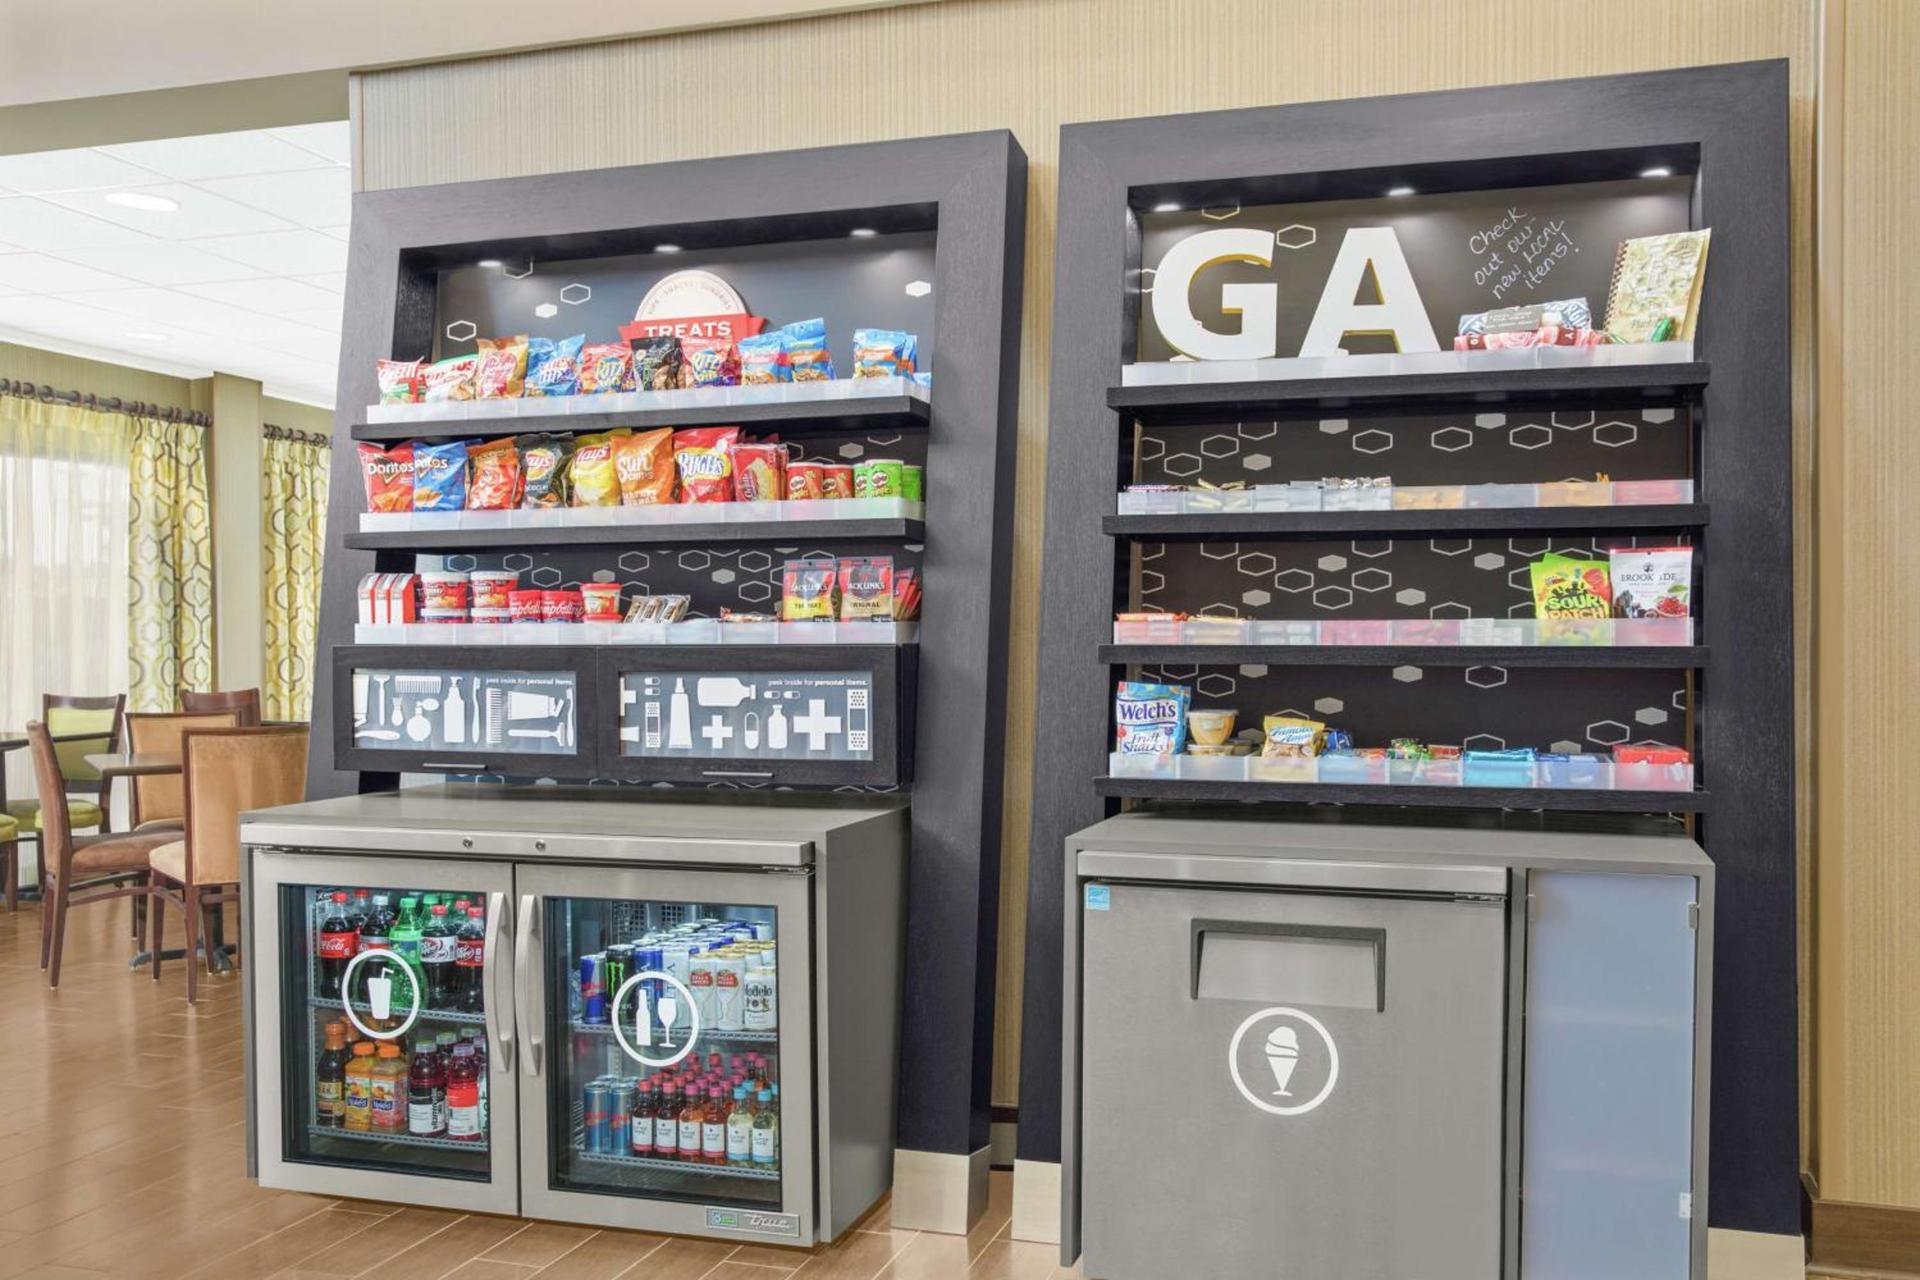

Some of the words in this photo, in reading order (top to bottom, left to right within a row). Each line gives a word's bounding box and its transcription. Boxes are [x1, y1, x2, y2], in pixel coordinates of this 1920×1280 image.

[1469, 207, 1528, 254] Check
[1474, 252, 1504, 285] out
[1507, 217, 1536, 253] our
[1492, 264, 1521, 300] new
[643, 321, 732, 339] TREATS
[367, 461, 415, 475] Doritos
[1548, 594, 1600, 610] SOUR
[815, 679, 845, 687] personal
[1120, 703, 1175, 720] Welch's
